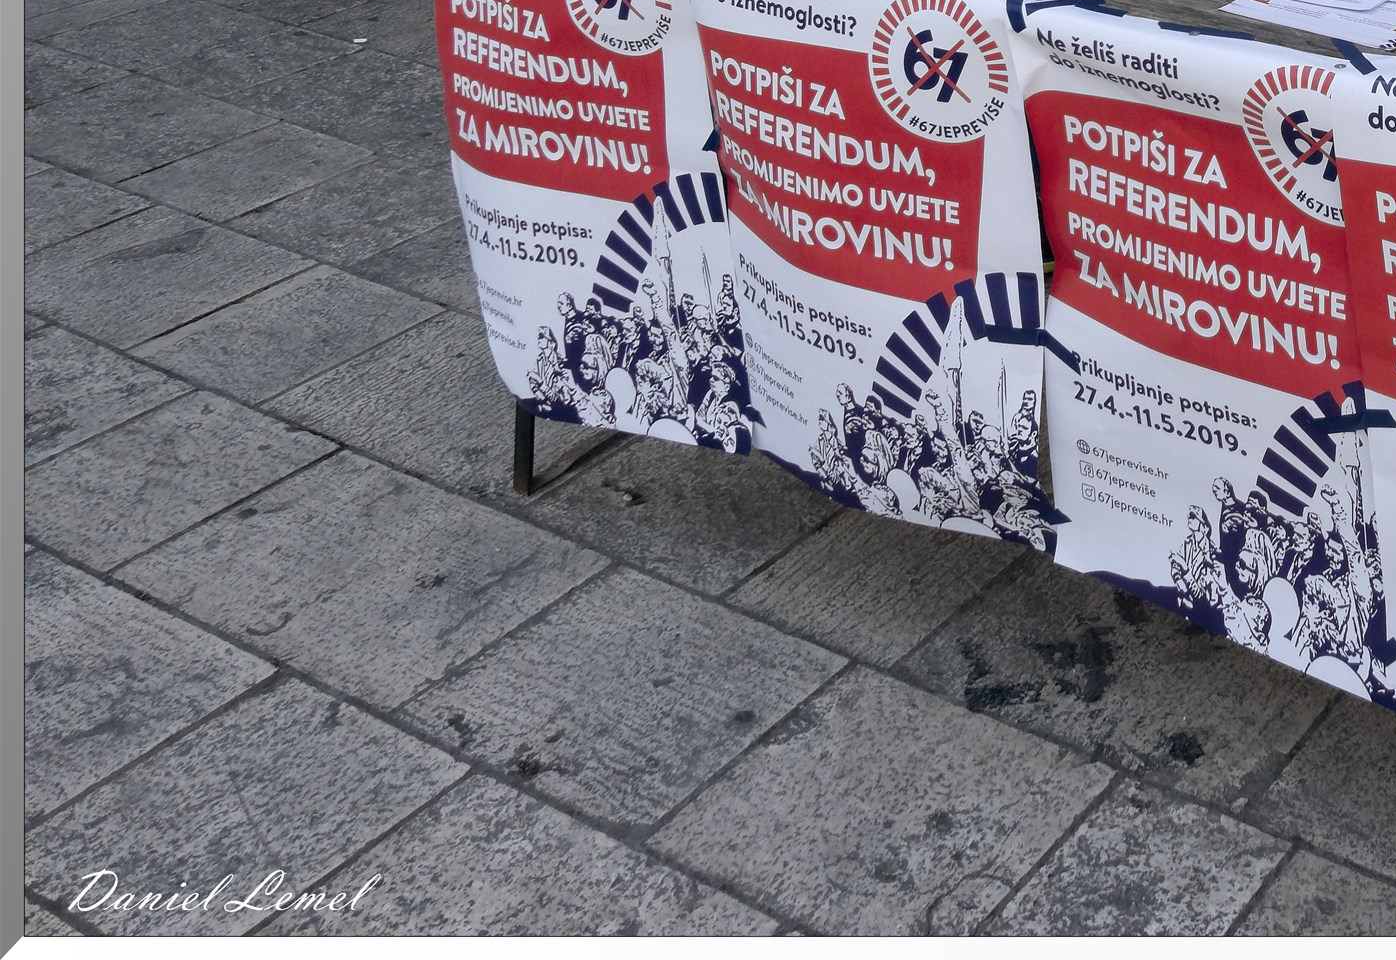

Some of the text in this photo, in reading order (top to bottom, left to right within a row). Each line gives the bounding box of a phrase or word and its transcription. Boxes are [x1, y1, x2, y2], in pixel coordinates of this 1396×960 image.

[523, 10, 550, 42] ZA
[600, 13, 672, 52] #67JEPREVIŠE
[1037, 27, 1179, 79] Ne želiš raditi
[453, 27, 628, 97] REFERENDUM,
[710, 49, 845, 120] POTPIŠI ZA
[903, 29, 969, 103] 67
[1049, 52, 1221, 112] do iznemoglosti?
[453, 73, 651, 132] PROMIJENIMO UVJETE
[909, 97, 1005, 139] #67JEPREVIŠE
[456, 108, 651, 175] ZA MIROVINU!
[715, 90, 936, 187] REFERENDUM,
[1063, 114, 1228, 189] POTPIŠI ZA
[1280, 110, 1338, 182] 67
[723, 133, 960, 225] PROMIJENIMO UVJETE
[465, 193, 593, 240] Prikupljanje potpisa:
[468, 219, 585, 268] 27.4.-11.5.2019.
[730, 168, 954, 271] ZA MIROVINU!
[1069, 158, 1322, 274] REFERENDUM,
[739, 252, 872, 338] Prikupljanje potpisa:
[1067, 211, 1347, 321] PROMIJENIMO UVJETE
[743, 279, 864, 364] 27.4.-11.5.2019.
[1073, 250, 1341, 370] ZA MIROVINU!
[753, 342, 803, 383] 67jeprevise.hr
[758, 386, 808, 426] 67jeprevise.hr
[1073, 380, 1248, 457] 27.4.-11.5.2019.
[1179, 394, 1258, 429] potpisa:
[1092, 446, 1169, 480] 67jeprevise.hr
[1096, 468, 1157, 498] 67jepreviše
[1098, 491, 1174, 528] 67jeprevise.hr
